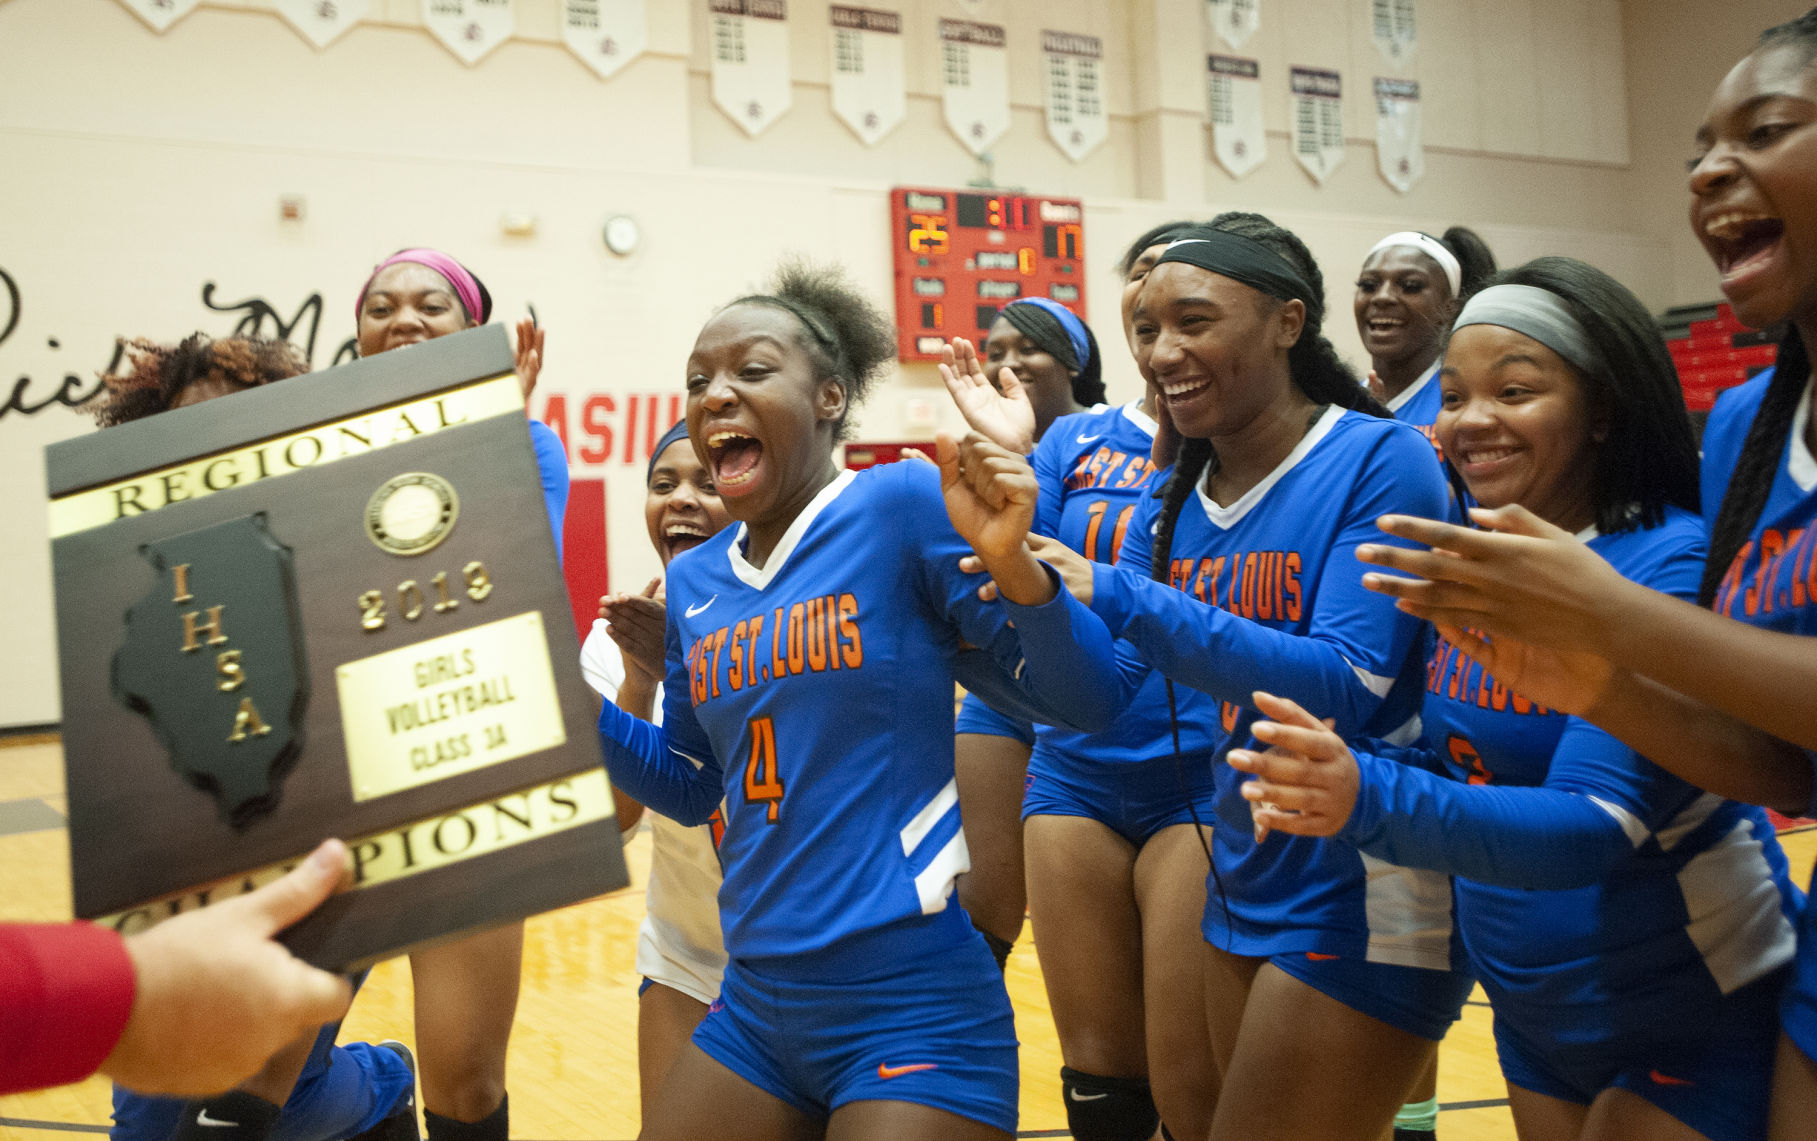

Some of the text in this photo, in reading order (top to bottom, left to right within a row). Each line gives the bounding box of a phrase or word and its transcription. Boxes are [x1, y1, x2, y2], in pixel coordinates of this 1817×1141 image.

[909, 214, 948, 255] 25
[112, 400, 467, 520] REGIONAL
[1227, 550, 1303, 622] LOUIS
[415, 648, 476, 689] GIRLS
[683, 626, 730, 707] AST
[771, 592, 863, 680] LOUIS
[386, 676, 516, 736] VOLLEYBALL
[410, 734, 472, 772] CLASS
[743, 715, 784, 825] 4
